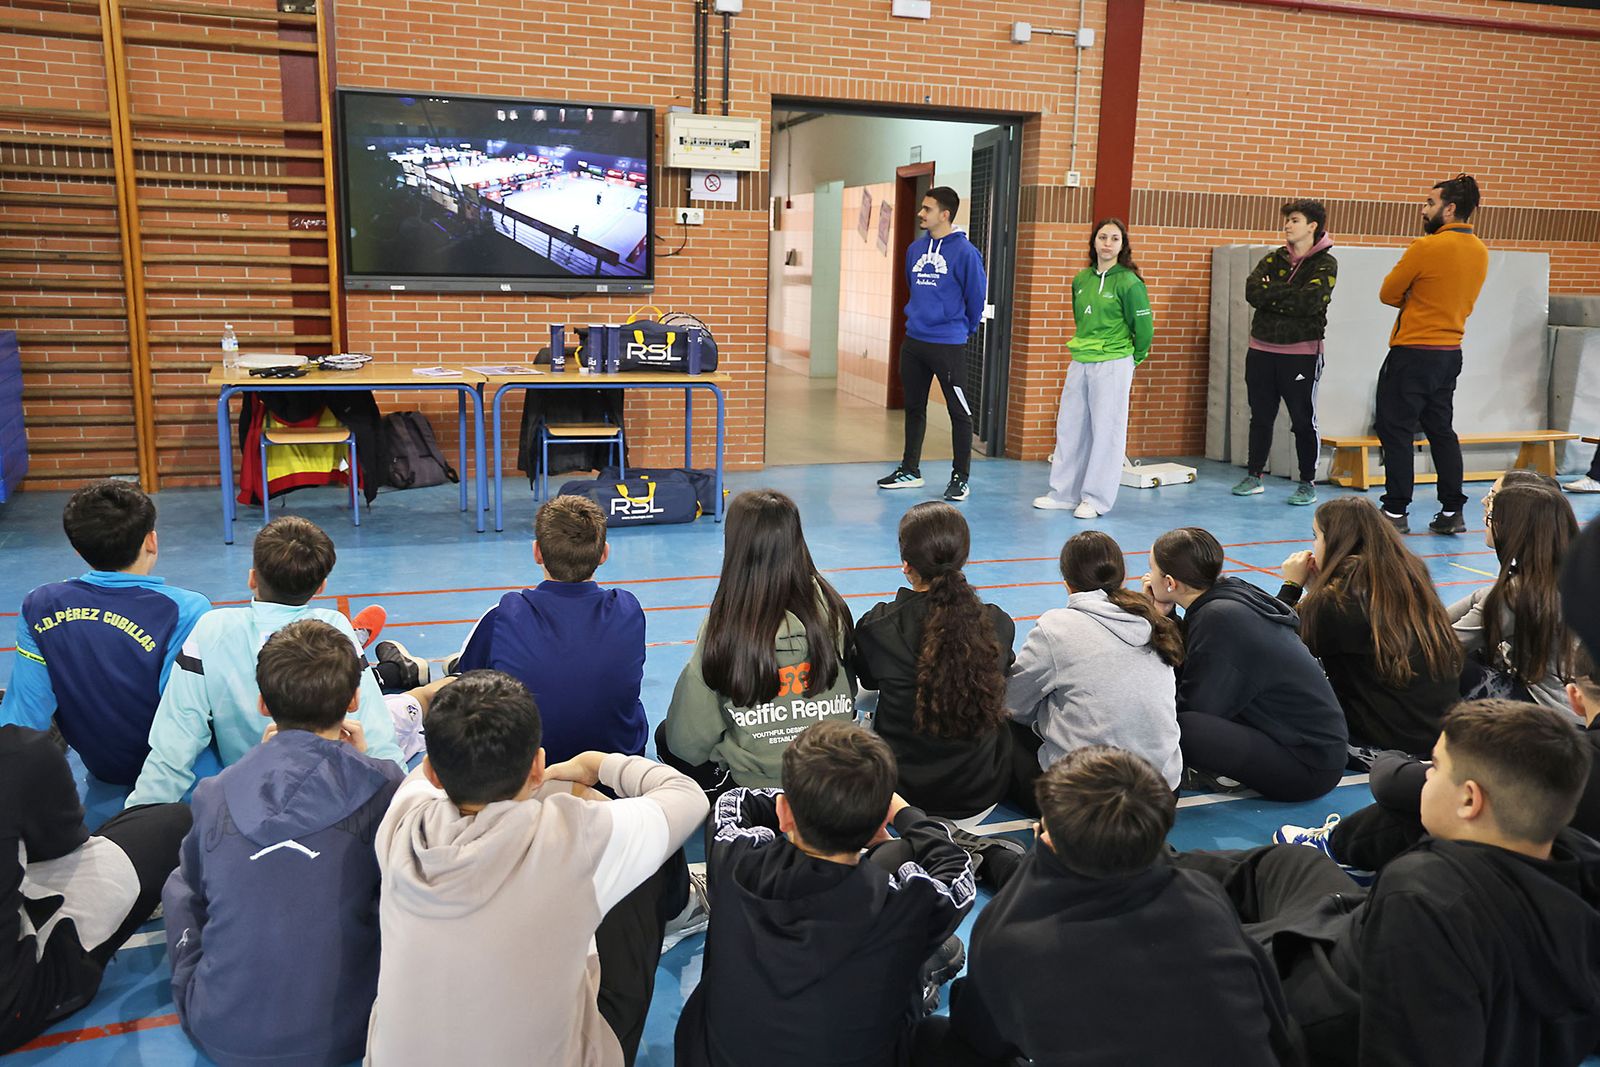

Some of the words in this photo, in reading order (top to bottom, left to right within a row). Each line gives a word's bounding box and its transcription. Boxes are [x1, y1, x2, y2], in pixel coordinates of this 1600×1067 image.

[626, 342, 681, 361] RSL
[610, 496, 664, 515] RSL
[103, 611, 156, 652] CUBILLAS
[791, 693, 852, 720] Republic
[752, 729, 785, 739] YOUTHFUL
